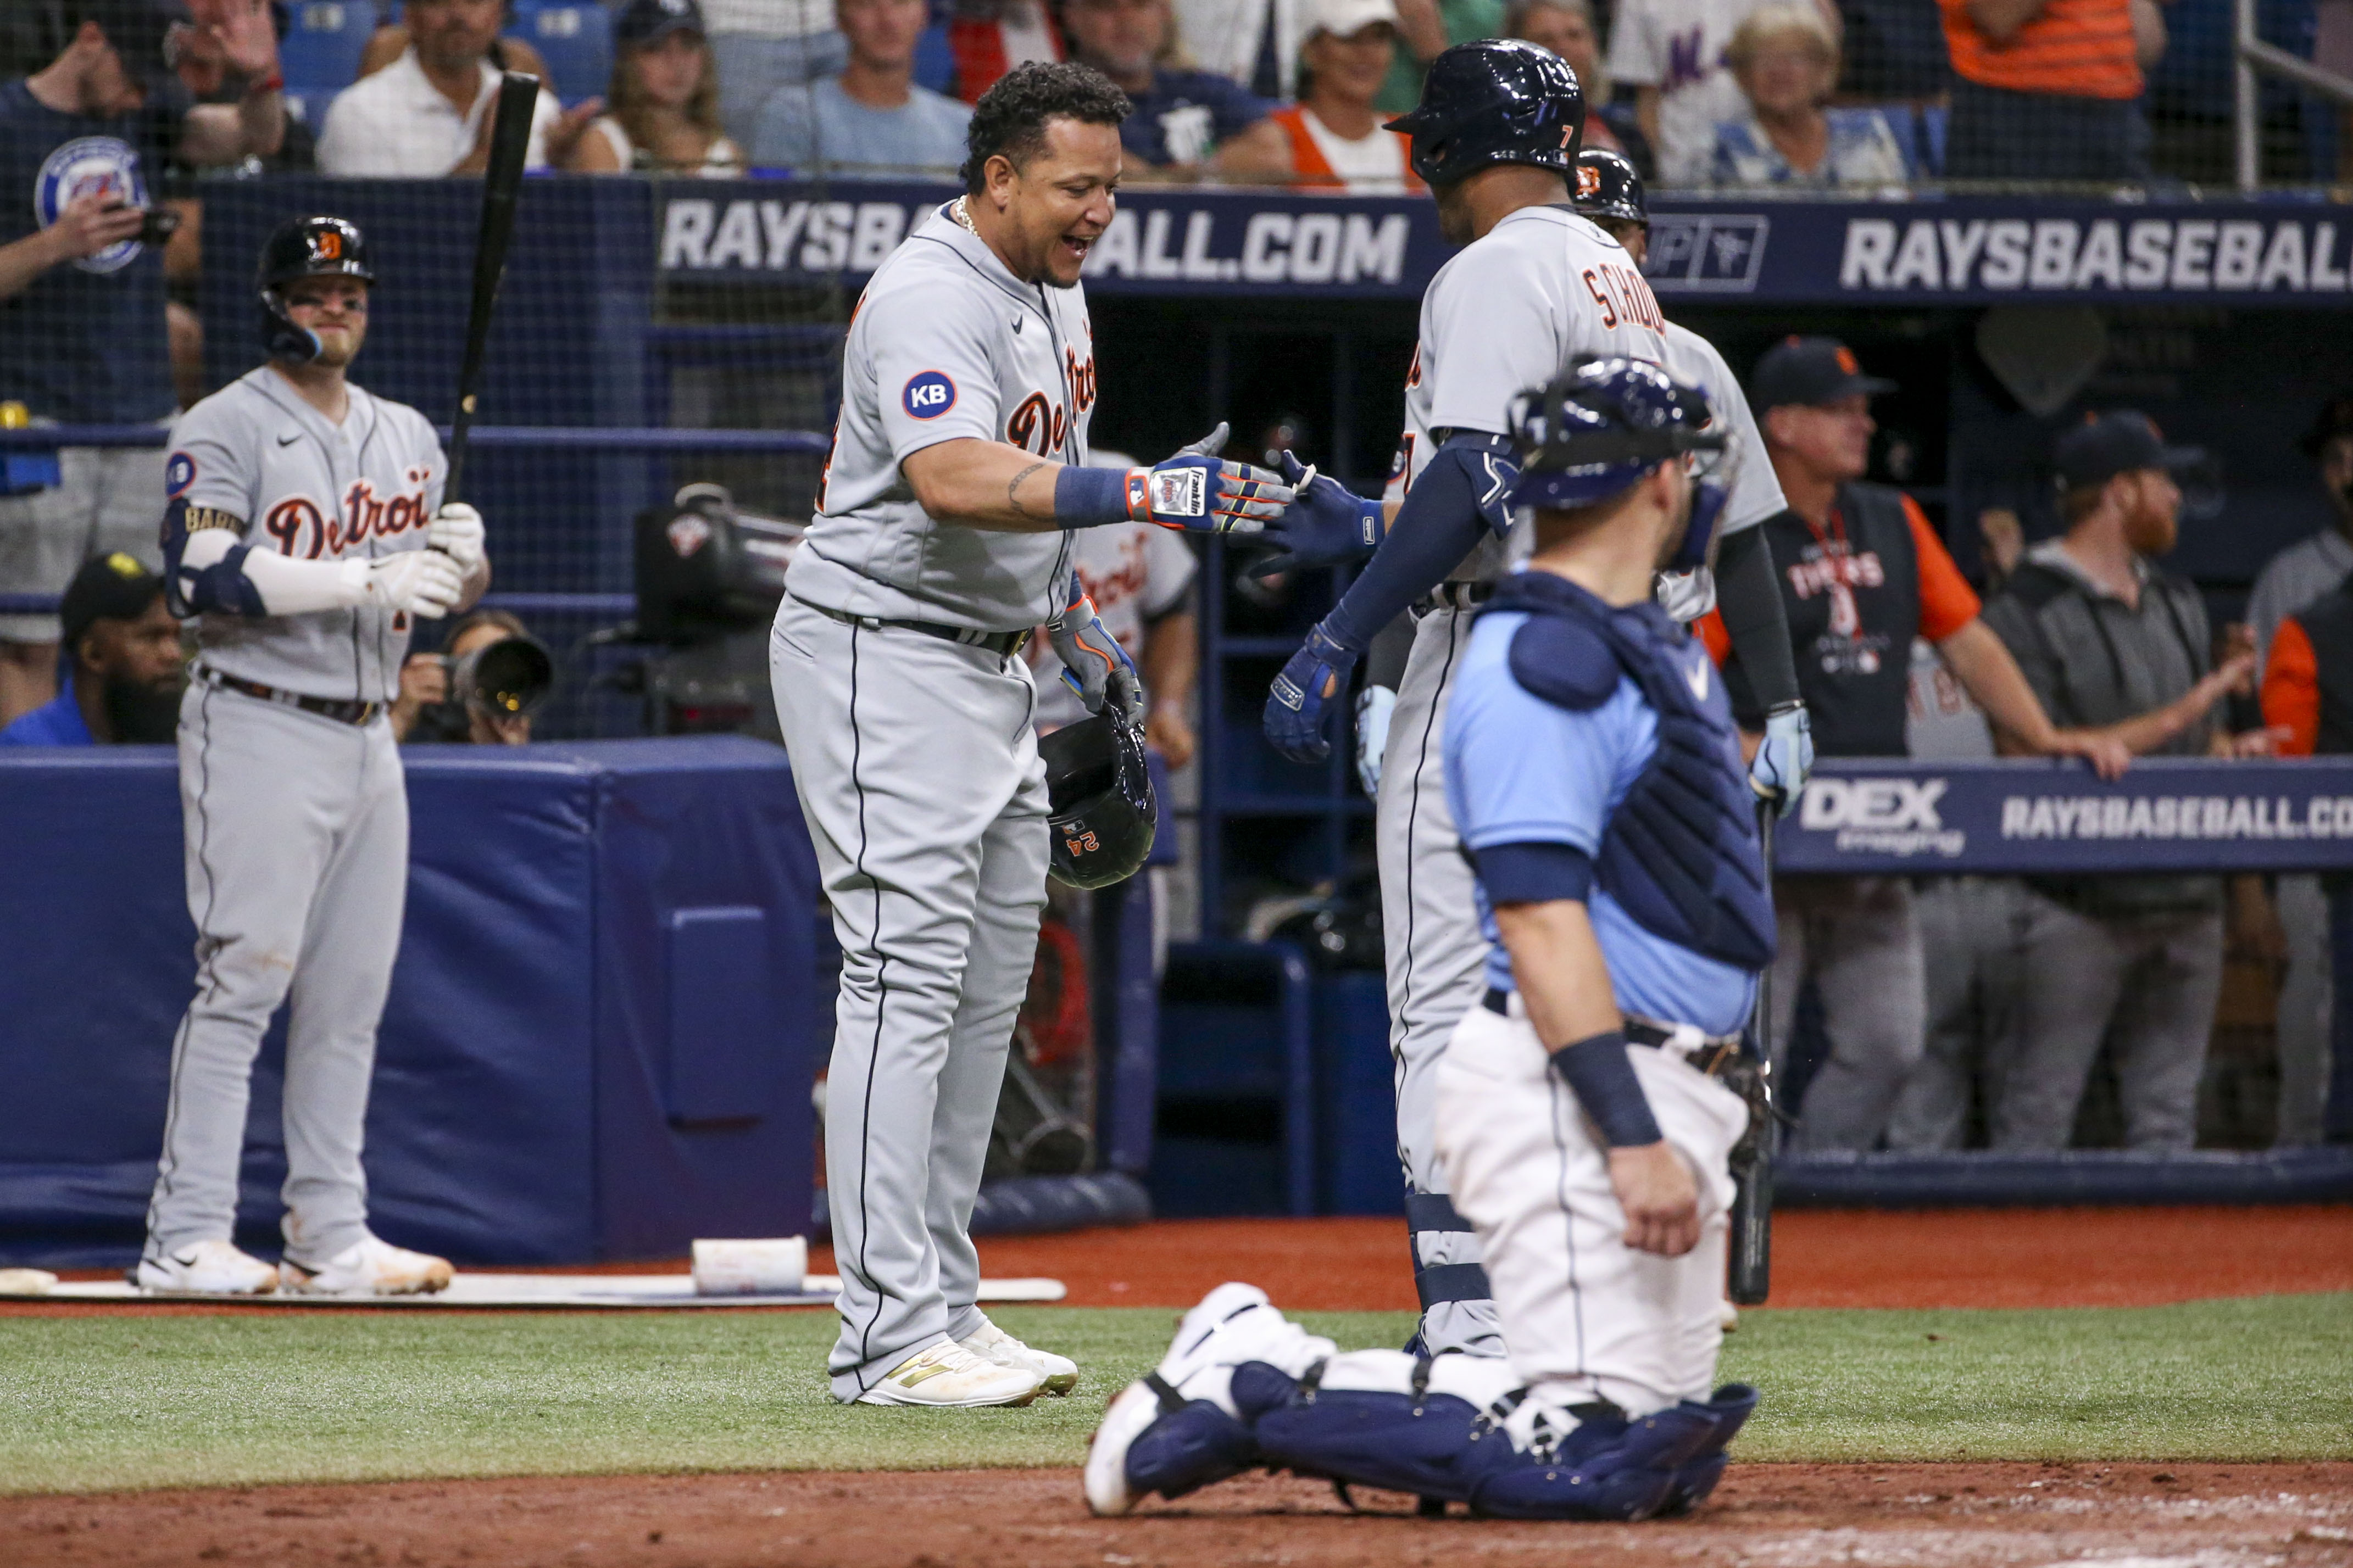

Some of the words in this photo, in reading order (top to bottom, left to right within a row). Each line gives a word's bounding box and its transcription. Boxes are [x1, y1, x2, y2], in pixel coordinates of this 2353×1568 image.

[1560, 125, 1573, 149] 7
[660, 199, 1410, 283] RAYSBALL.COM
[1839, 219, 2353, 291] RAYSBASEBAL
[1582, 263, 1666, 337] SCHOO
[911, 383, 947, 408] KB
[266, 469, 430, 560] Detroi
[1800, 777, 1948, 830] DEX
[1066, 831, 1099, 857] 24
